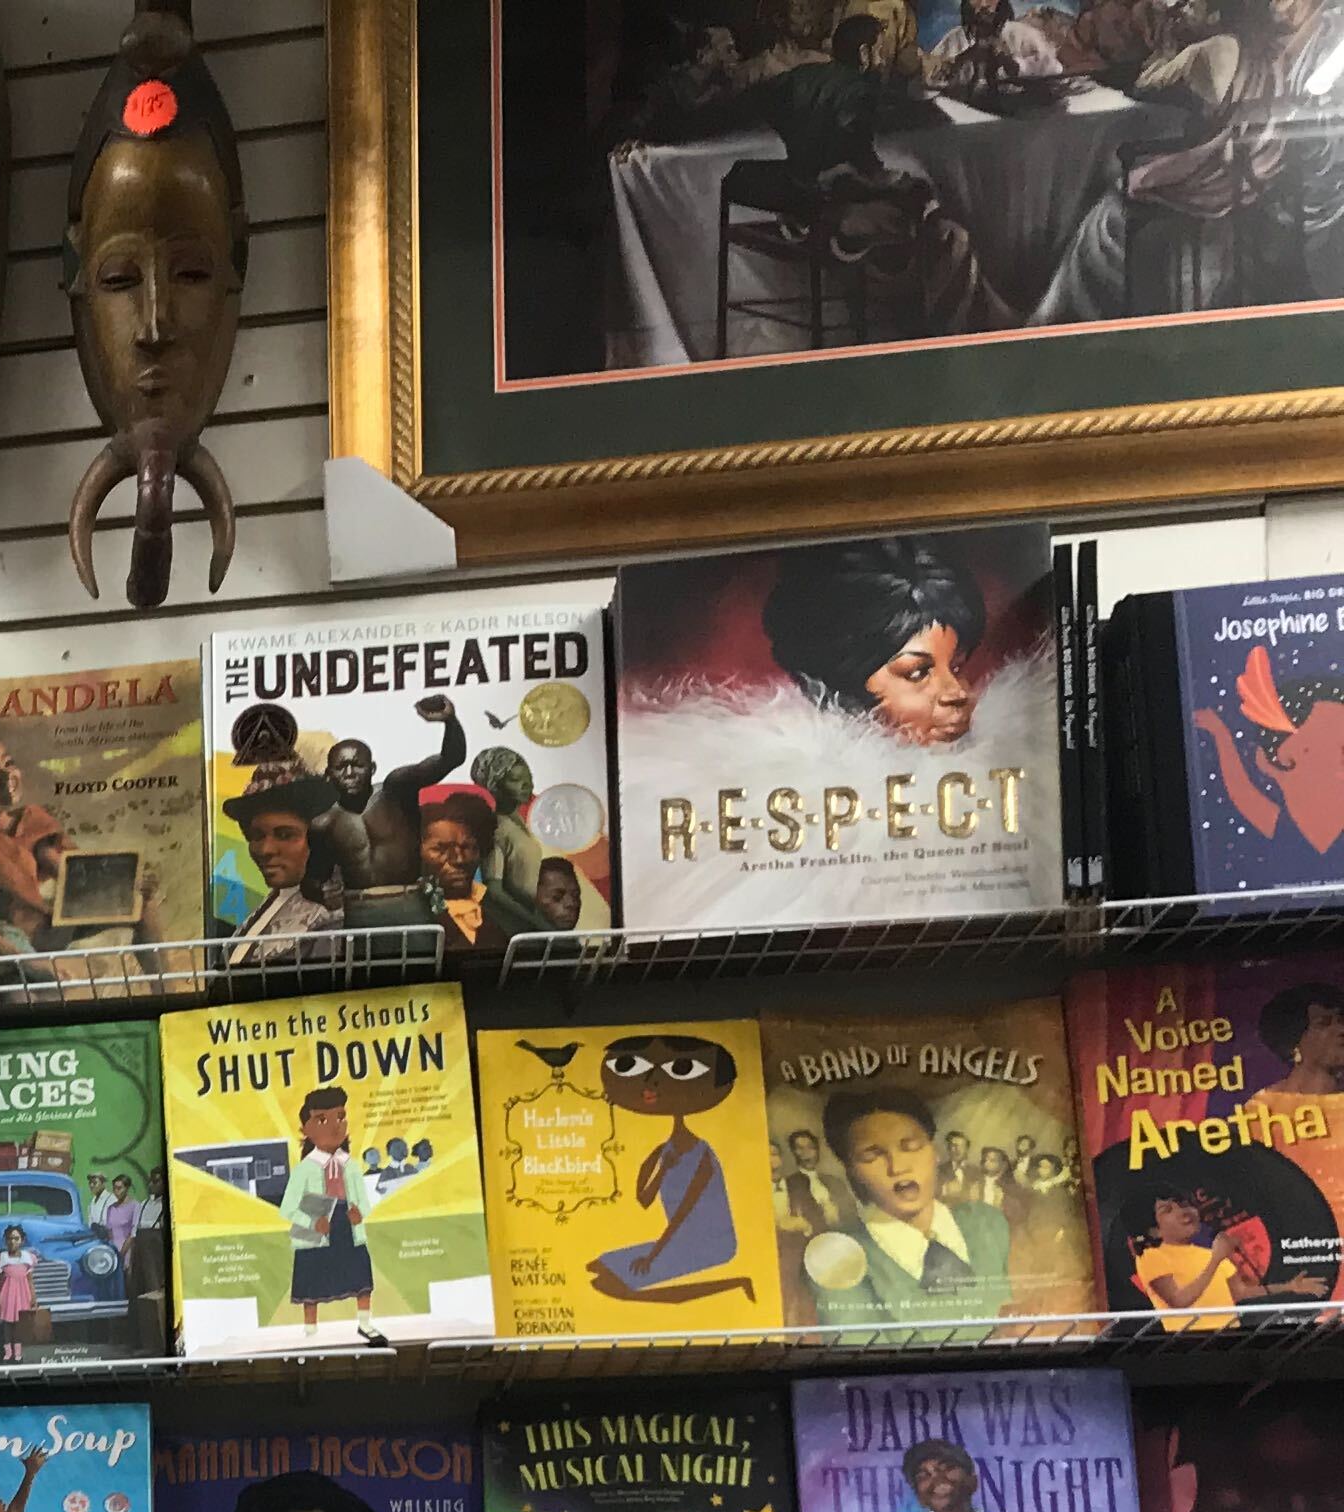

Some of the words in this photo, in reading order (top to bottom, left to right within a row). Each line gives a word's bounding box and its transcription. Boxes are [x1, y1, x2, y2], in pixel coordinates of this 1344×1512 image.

[228, 633, 298, 651] KWAME
[304, 622, 418, 645] ALEXANDER
[441, 615, 500, 634] KADIR
[507, 610, 584, 629] NELSON
[1213, 611, 1328, 645] Josephine
[226, 656, 249, 702] THE
[253, 631, 589, 699] UNDEFEATED
[739, 858, 795, 873] Aretha
[913, 846, 966, 863] Queen
[1156, 986, 1178, 1013] A
[207, 1019, 278, 1045] When
[286, 1010, 327, 1037] the
[337, 1000, 431, 1033] Schools
[1124, 1015, 1235, 1053] Voice
[196, 1050, 293, 1096] SHUT
[317, 1032, 447, 1084] DOWN
[1096, 1056, 1245, 1104] Named
[1127, 1100, 1331, 1171] Aretha
[42, 1415, 136, 1466] Soup
[525, 1418, 592, 1455] THIS
[600, 1414, 752, 1452] MAGICAL,
[518, 1454, 651, 1491] MUSICAL
[659, 1452, 753, 1488] NIGHT
